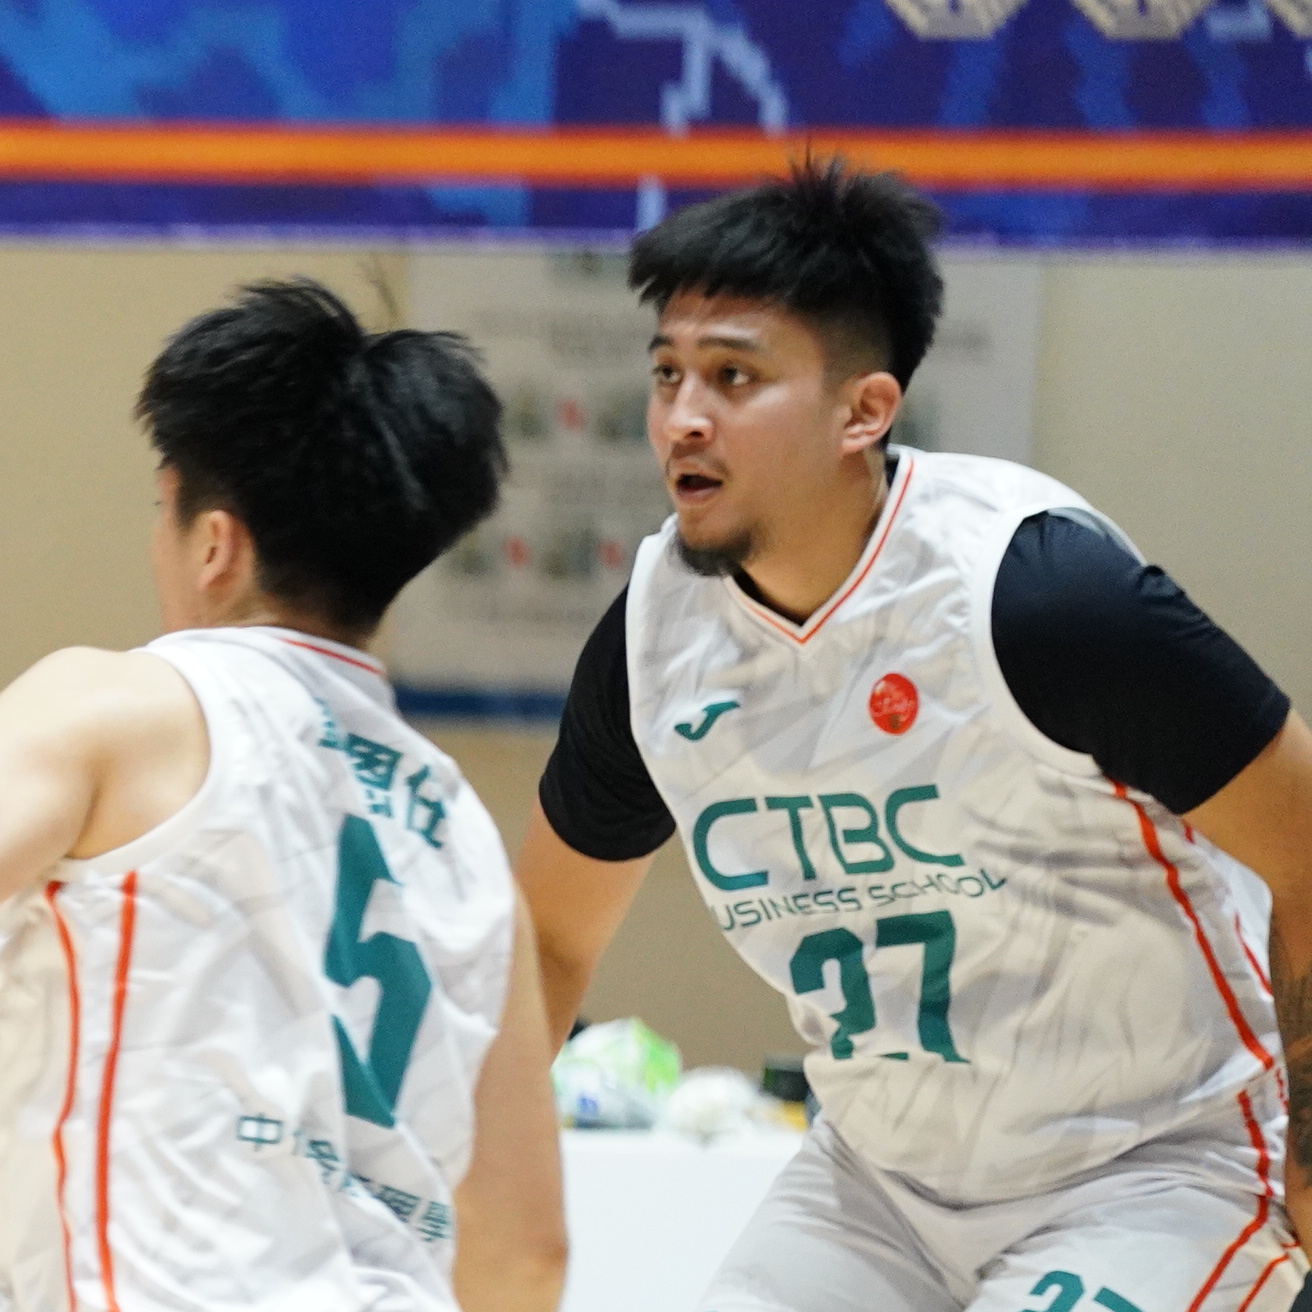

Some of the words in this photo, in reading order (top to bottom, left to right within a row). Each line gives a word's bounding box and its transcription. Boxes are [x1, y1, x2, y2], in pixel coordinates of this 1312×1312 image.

[693, 784, 966, 892] CTBC
[710, 888, 863, 931] USINESS
[869, 868, 1007, 908] SCHOOL
[322, 813, 432, 1129] 5
[789, 909, 972, 1064] 27
